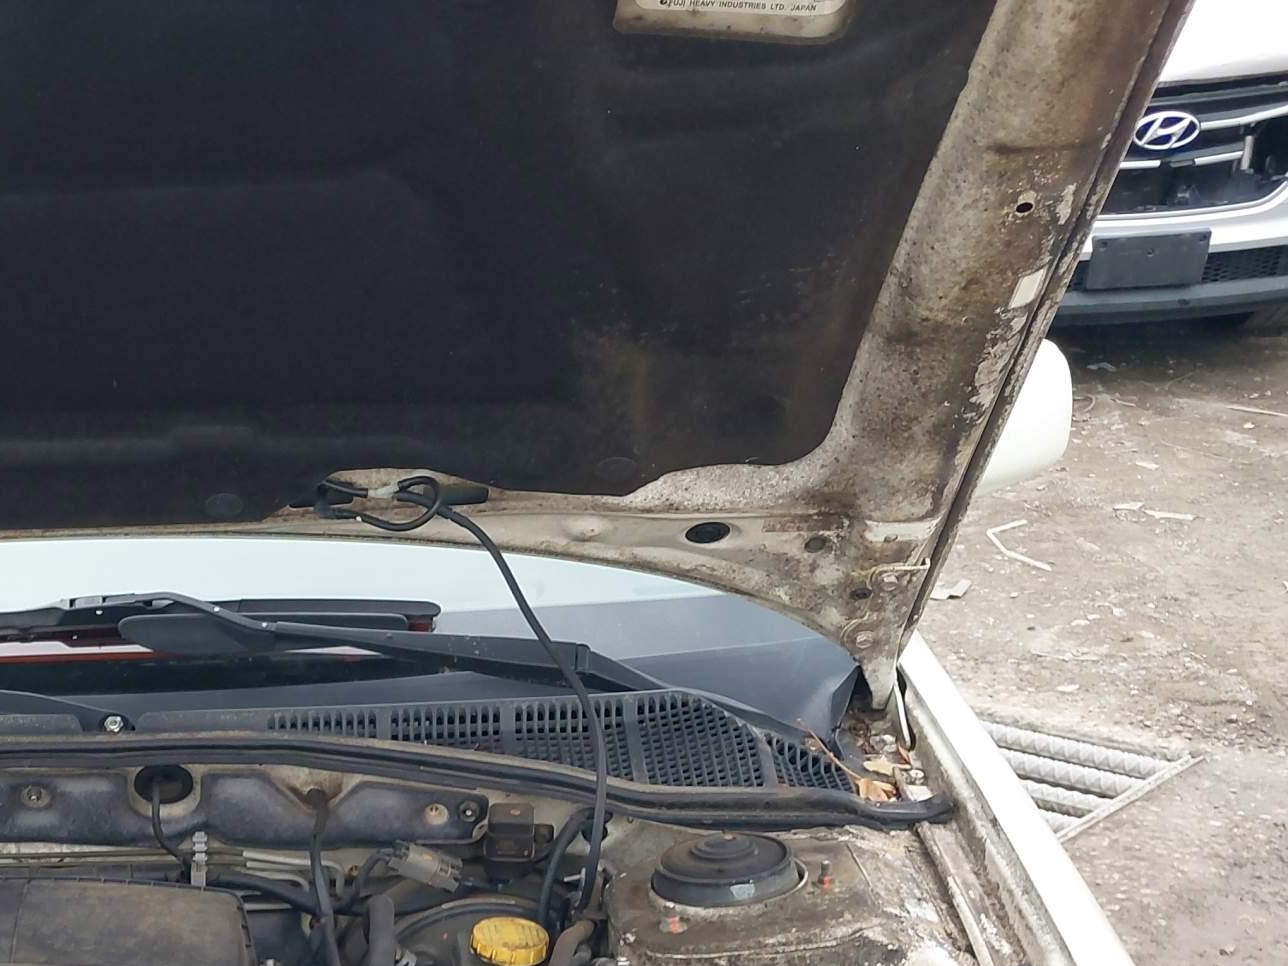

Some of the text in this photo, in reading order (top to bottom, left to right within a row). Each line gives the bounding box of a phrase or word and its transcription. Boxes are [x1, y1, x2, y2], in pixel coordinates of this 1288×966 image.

[690, 0, 714, 8] HEAVY
[718, 1, 767, 10] INDUSTRIES
[790, 4, 817, 12] JAPAN
